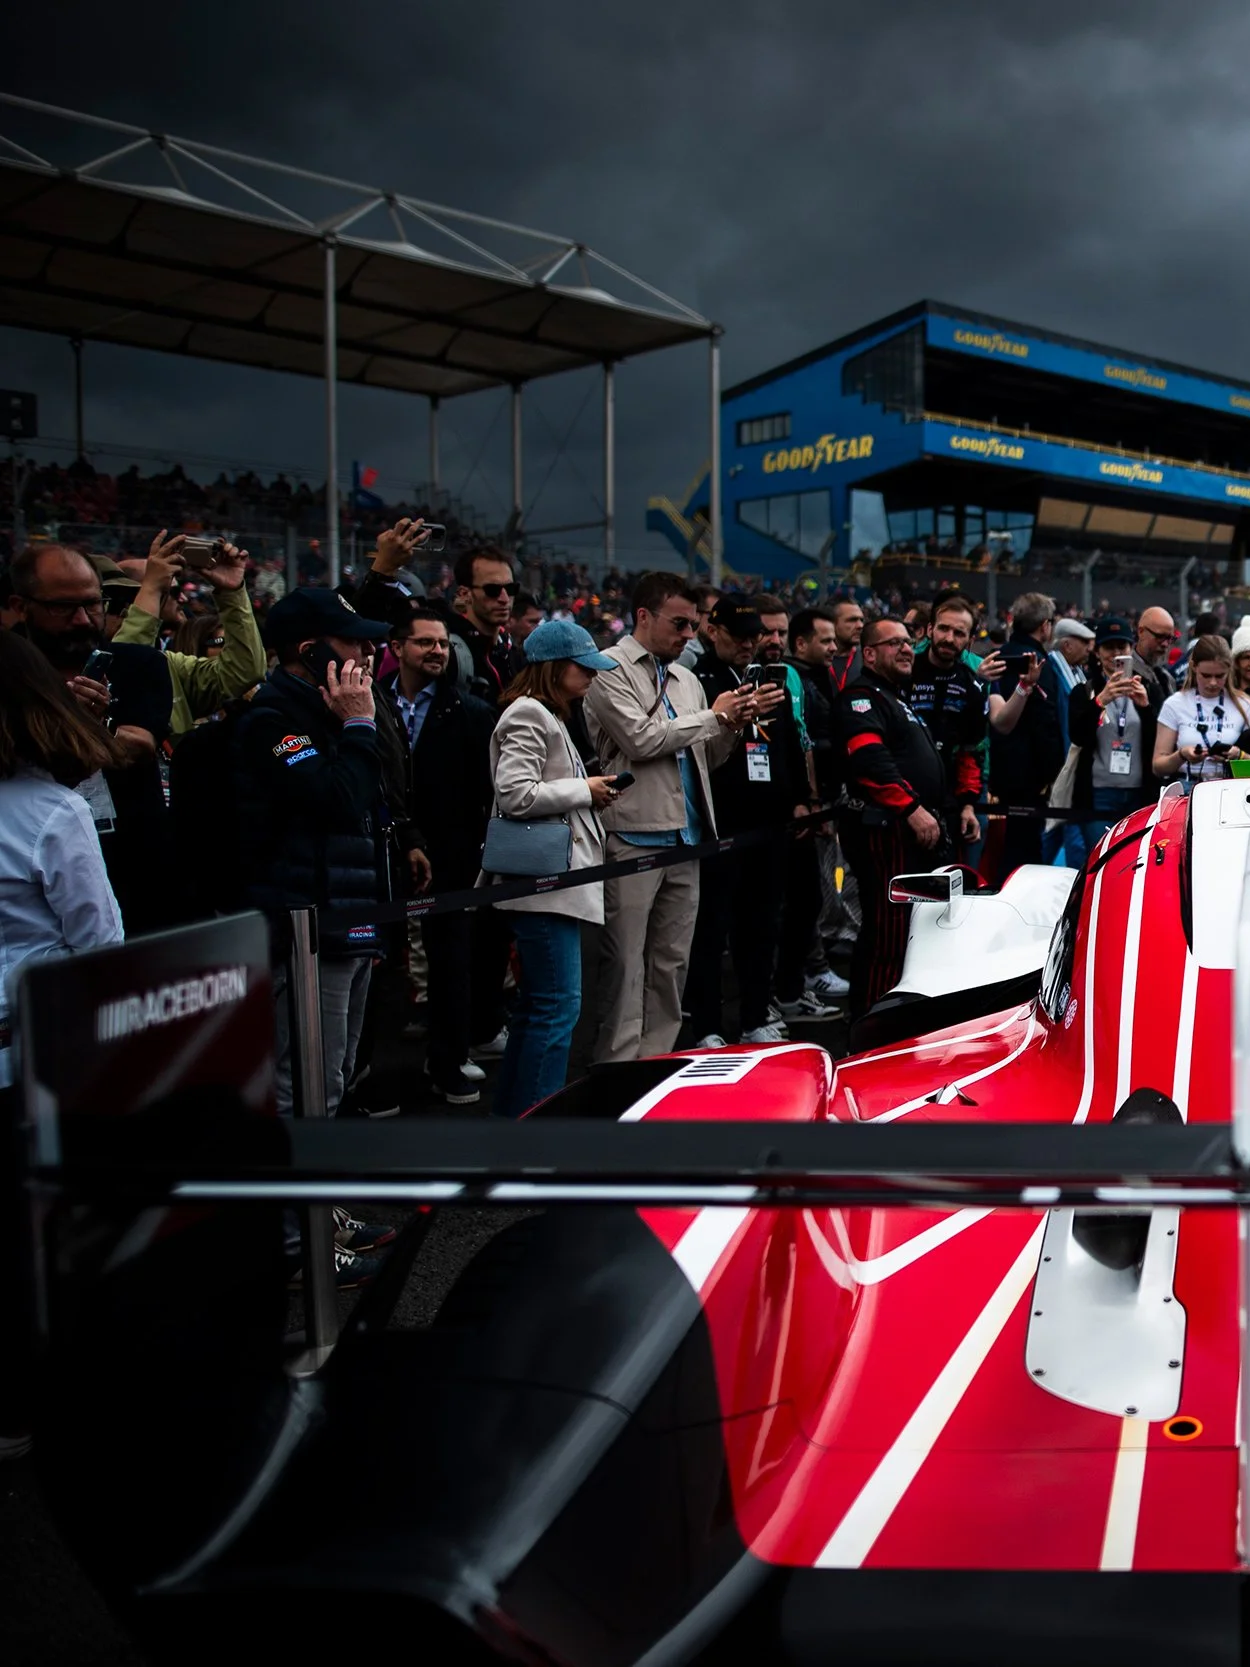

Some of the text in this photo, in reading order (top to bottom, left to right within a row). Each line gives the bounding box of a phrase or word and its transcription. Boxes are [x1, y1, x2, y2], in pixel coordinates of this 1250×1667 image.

[954, 329, 1029, 358] GOODYEAR
[1104, 364, 1167, 390] GOODYEAR
[762, 433, 874, 473] GOODYEAR
[950, 435, 1025, 459] GOODYEAR
[1100, 461, 1163, 483] GOODYEAR
[275, 736, 311, 754] MARTINI
[127, 963, 249, 1033] RACEBORN
